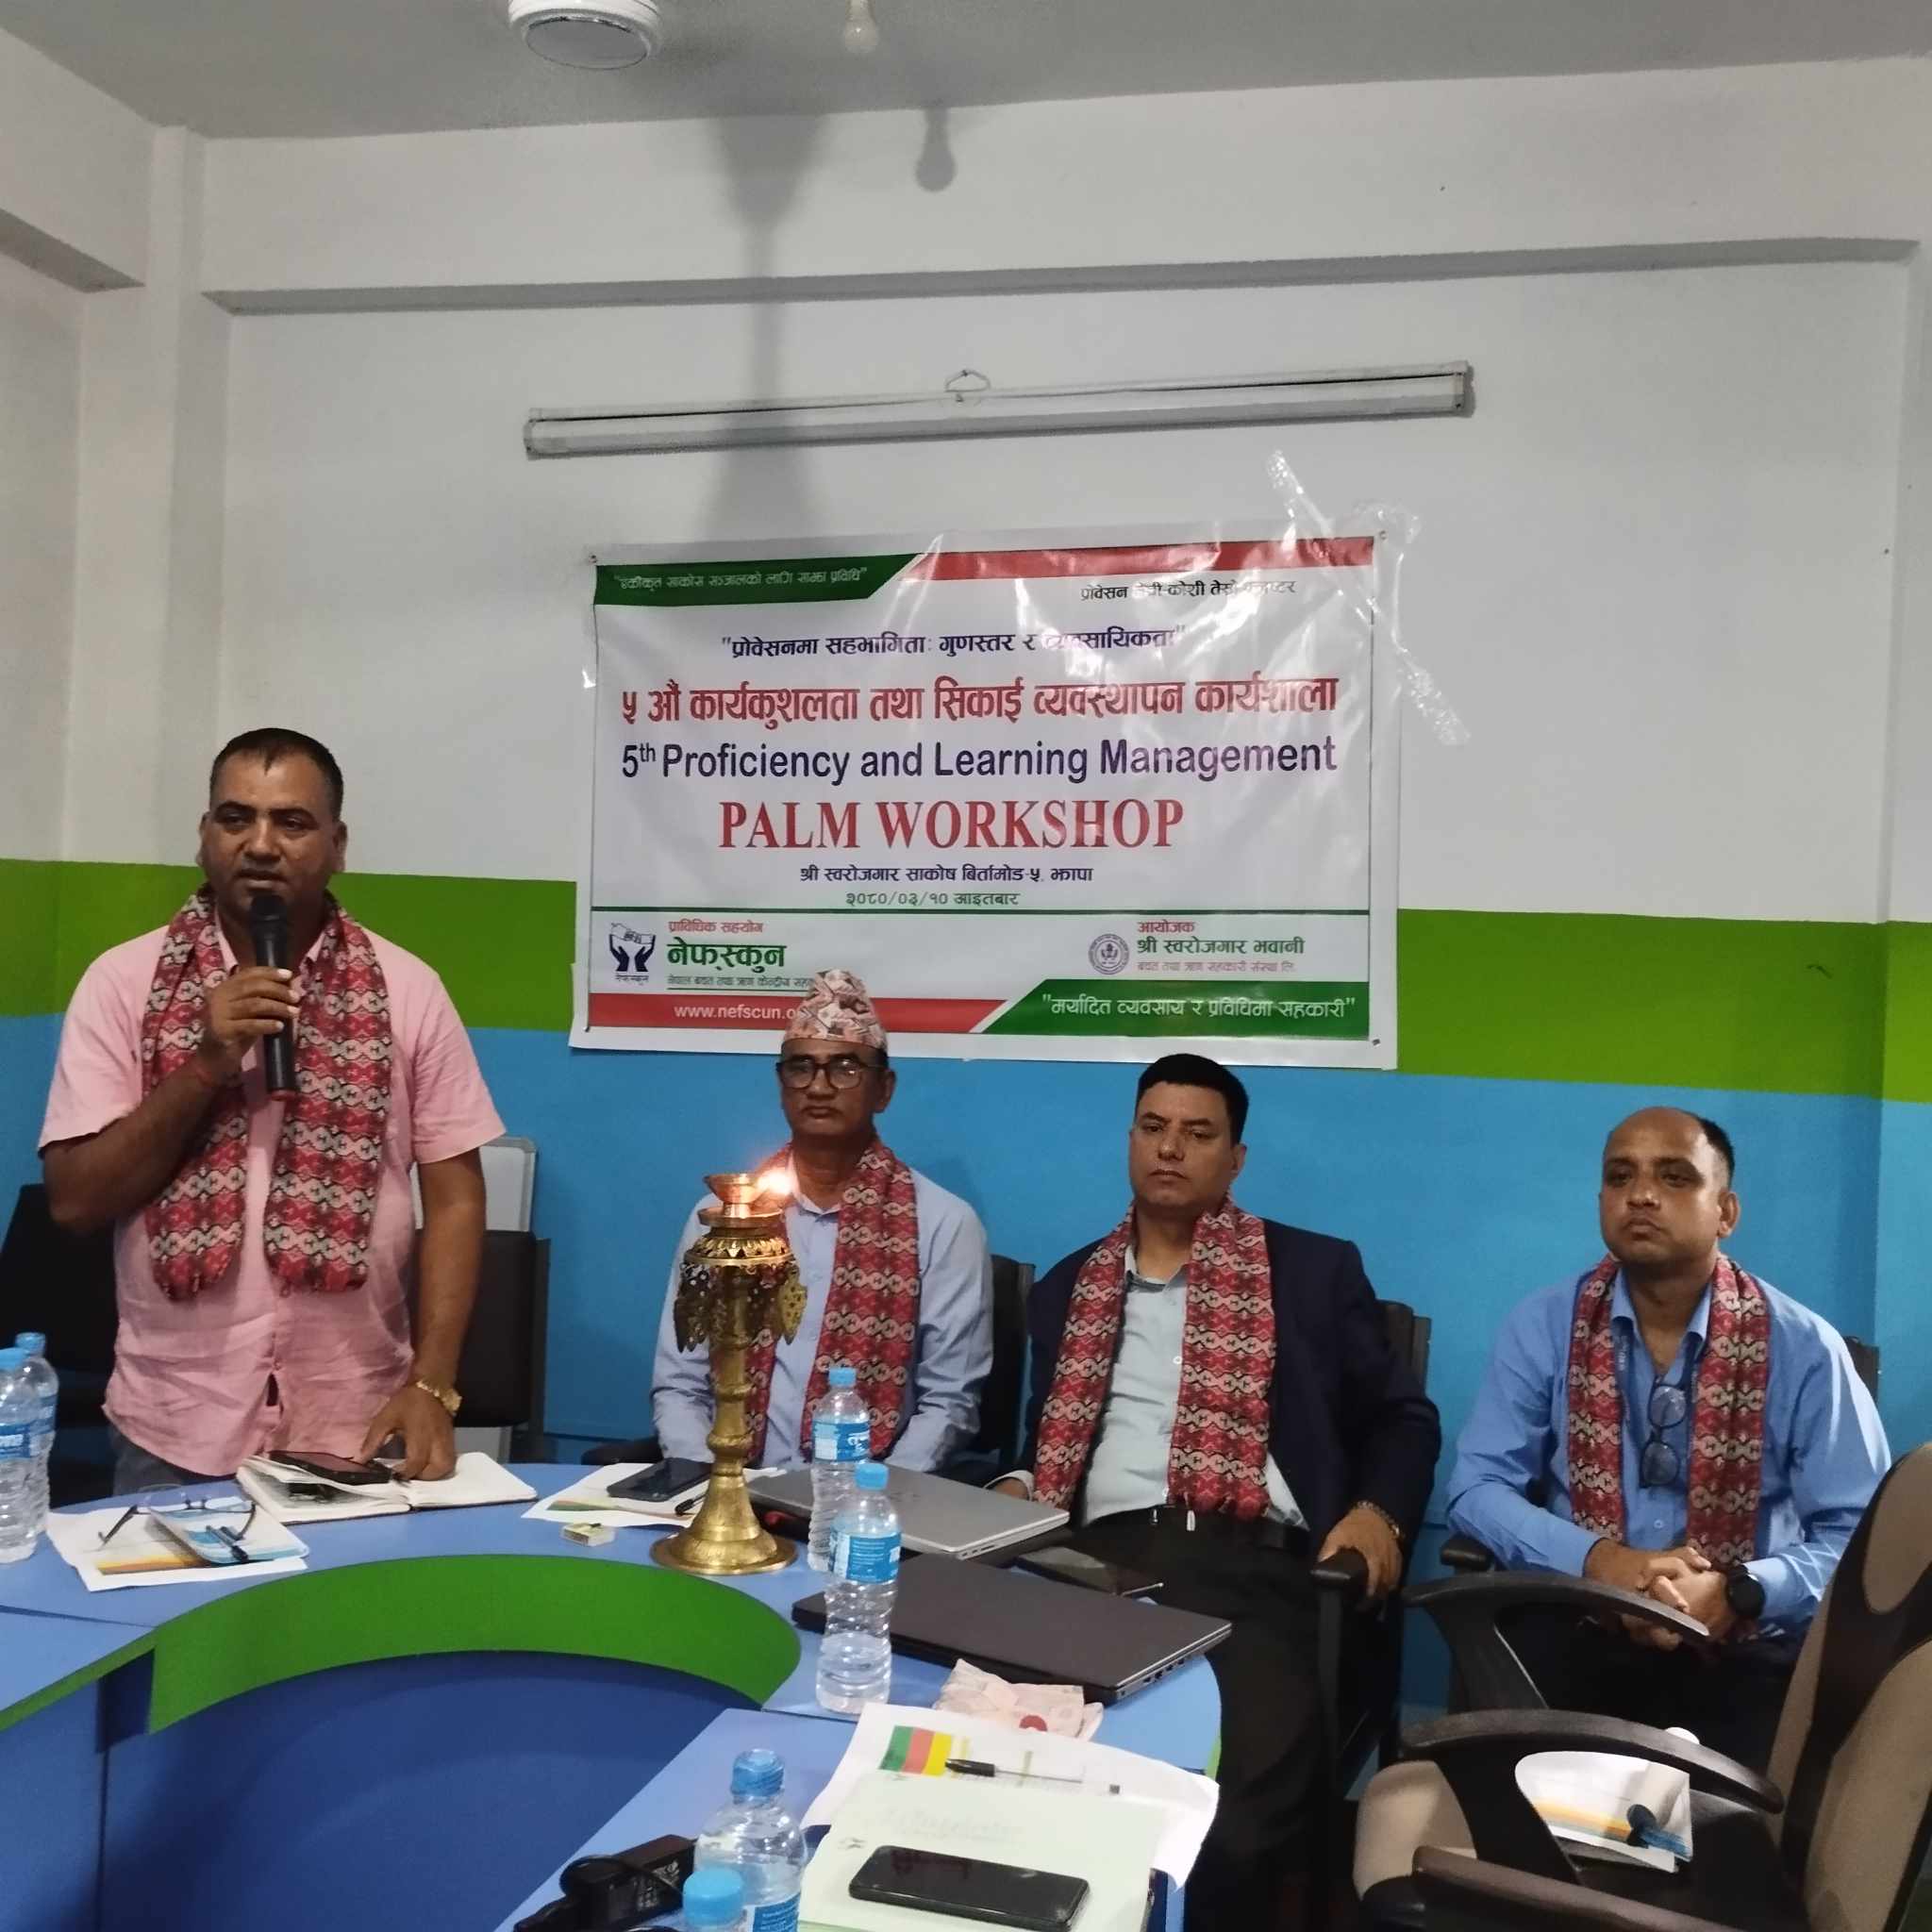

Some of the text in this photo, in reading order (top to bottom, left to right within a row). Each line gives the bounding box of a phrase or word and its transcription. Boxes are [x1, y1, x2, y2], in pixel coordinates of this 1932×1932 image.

[939, 633, 1016, 658] गुणस्तर
[1023, 633, 1038, 651] र
[622, 691, 638, 724] ५
[690, 680, 860, 730] कार्यकुशलता
[870, 688, 925, 722] तथा
[934, 675, 1024, 724] सिकाई
[1033, 680, 1186, 719] व्यवस्थापन
[1195, 670, 1340, 714] कार्यशाला
[622, 735, 1338, 787] 5th Proficiency and Learning Management
[718, 798, 1185, 849] PALM WORKSHOP
[800, 862, 819, 883] श्री
[824, 863, 900, 883] स्वरोजगार
[906, 863, 957, 883] साकोष
[1050, 867, 1094, 883] झापा
[845, 891, 1021, 908] २०८०/०३/१० आइतबार
[721, 920, 764, 934] सहयोग
[1137, 919, 1195, 934] आयोजक
[1137, 936, 1158, 955] श्री
[1163, 935, 1246, 955] स्वरोजगार
[1253, 936, 1306, 955] भवानी
[674, 1004, 798, 1020] www.nefscun.o
[1117, 998, 1186, 1016] व्यवसाय
[1191, 999, 1205, 1016] र
[1208, 996, 1274, 1018] प्रविधिमा
